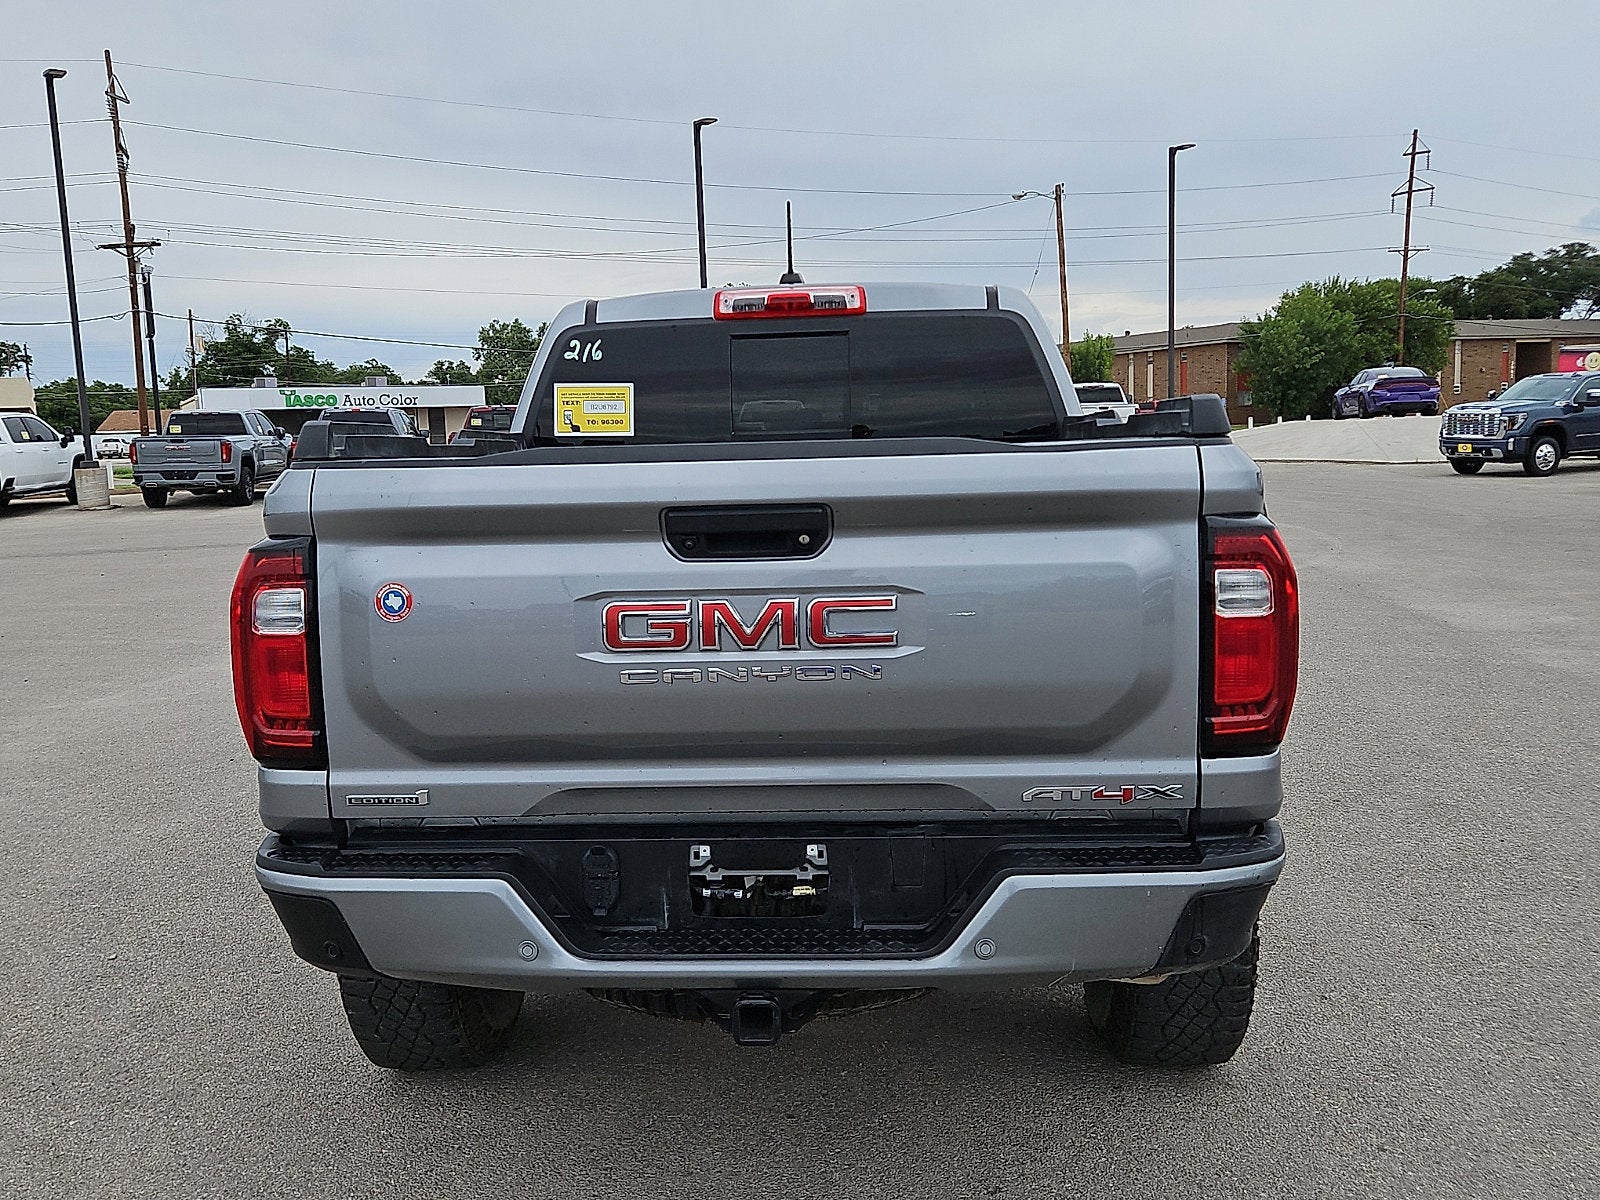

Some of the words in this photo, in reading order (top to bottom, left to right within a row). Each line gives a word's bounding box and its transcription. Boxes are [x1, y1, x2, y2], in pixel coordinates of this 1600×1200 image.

[563, 338, 603, 363] 216
[279, 389, 338, 407] TASCO
[342, 394, 376, 406] Auto
[379, 393, 419, 406] Color
[601, 594, 899, 652] GMC
[619, 664, 883, 685] CANYON
[350, 796, 417, 804] EDITION
[1021, 784, 1184, 805] AT4X
